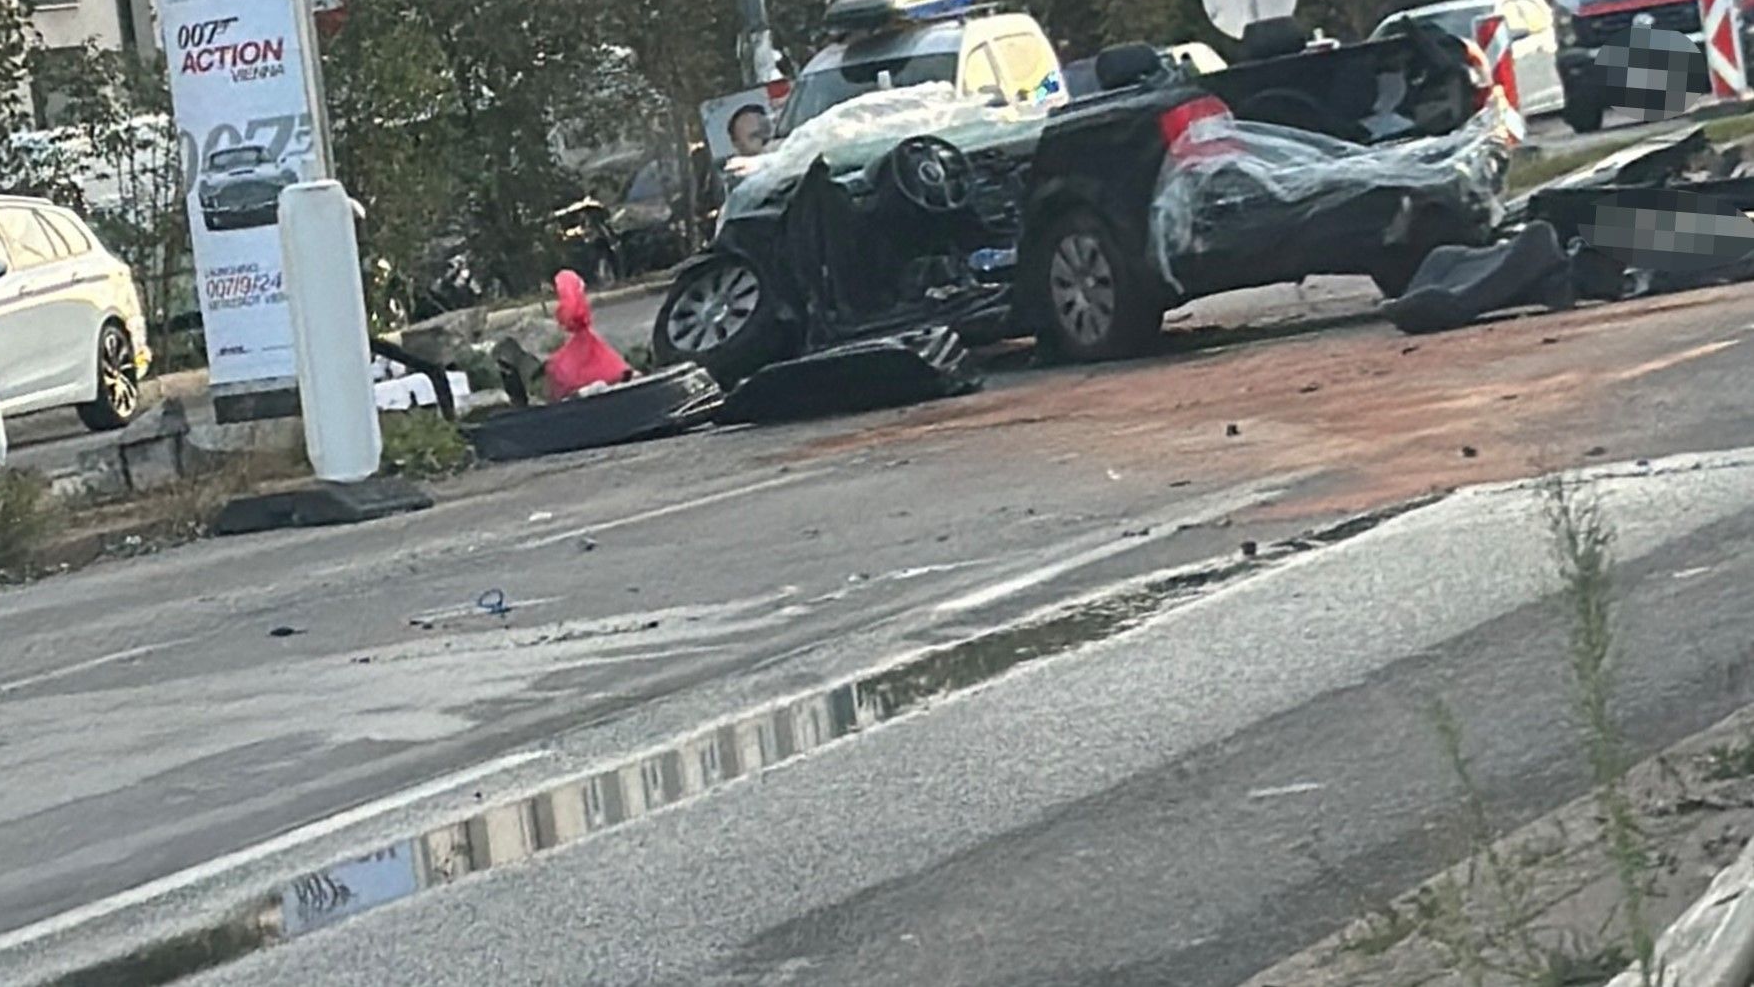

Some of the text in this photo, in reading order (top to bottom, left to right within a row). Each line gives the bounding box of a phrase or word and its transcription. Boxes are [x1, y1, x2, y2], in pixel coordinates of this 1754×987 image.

[177, 17, 239, 50] 007
[181, 36, 284, 74] ACTION
[230, 63, 285, 83] VIENNA
